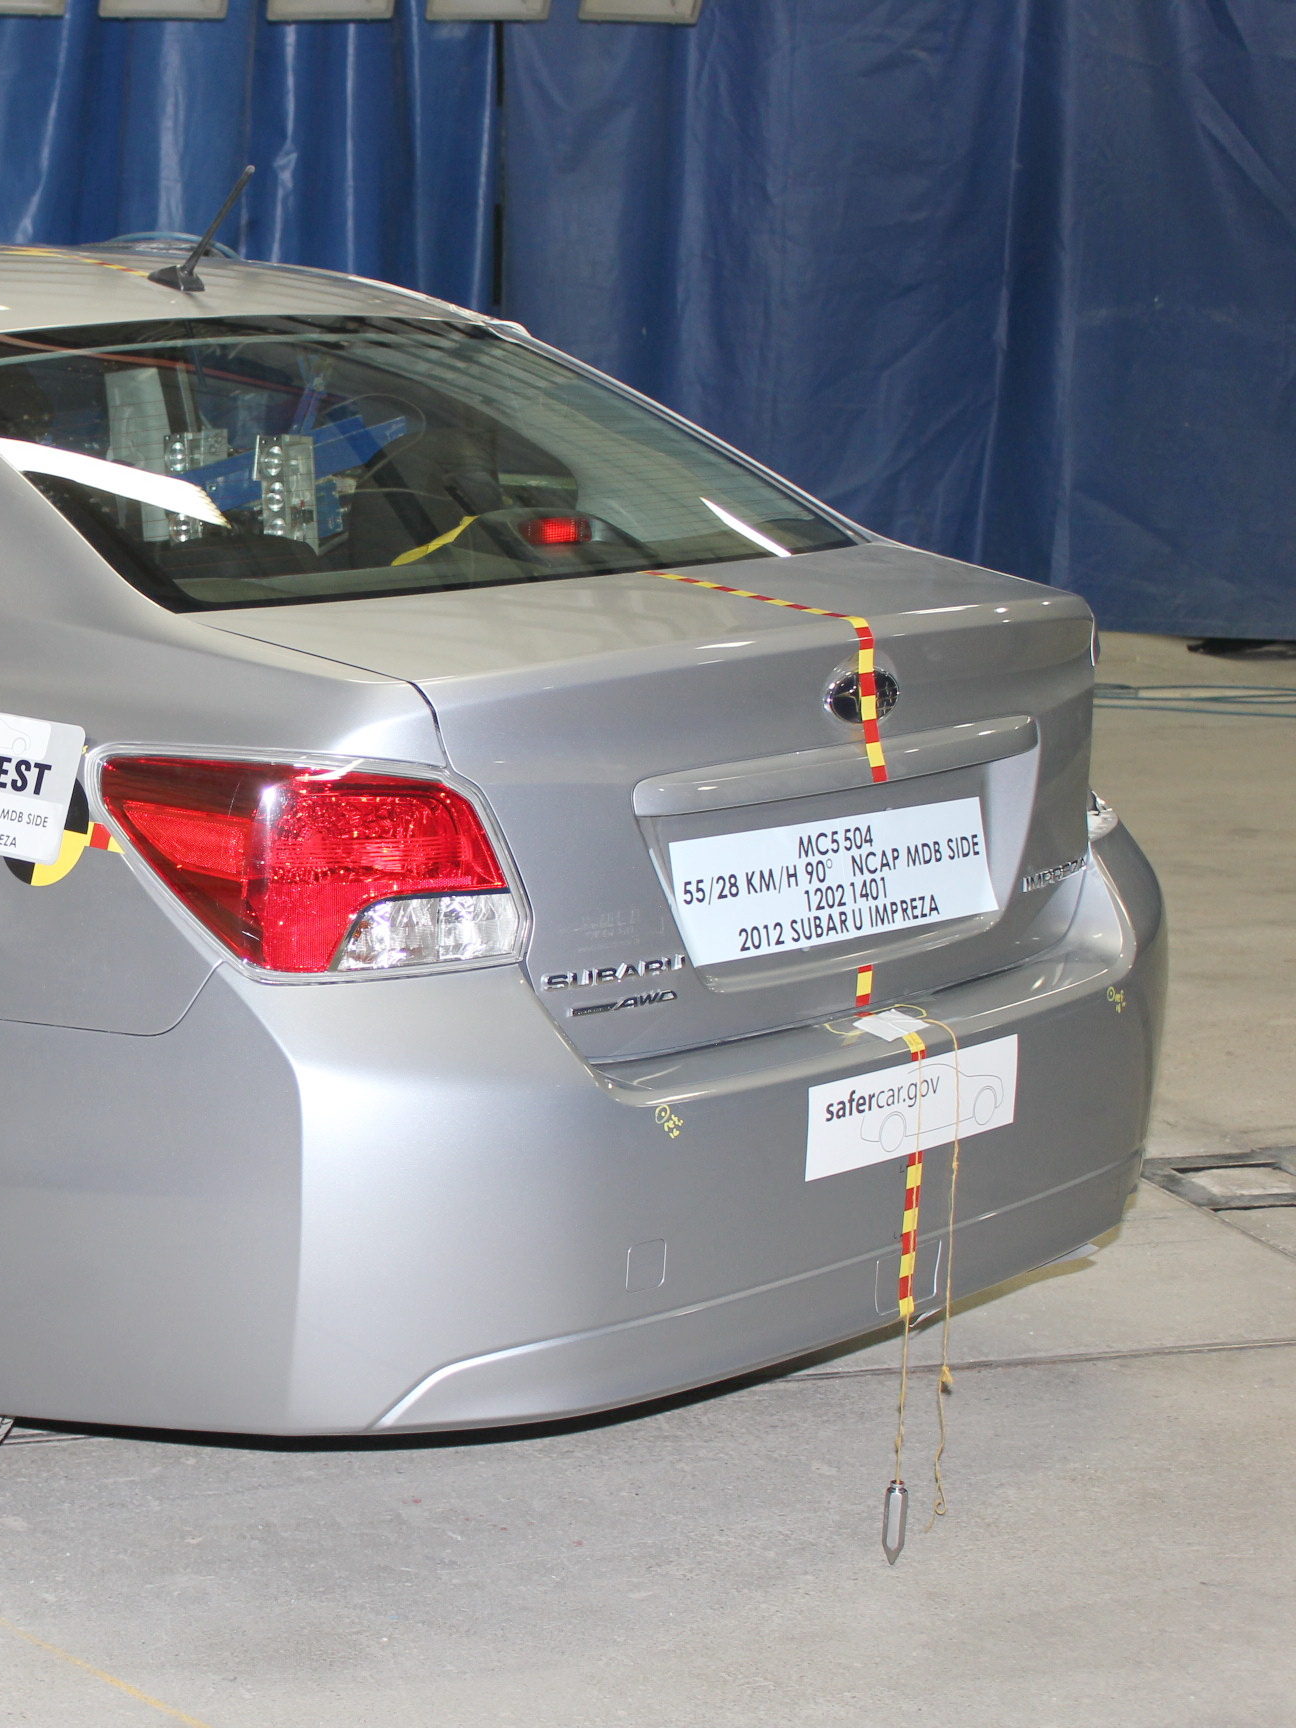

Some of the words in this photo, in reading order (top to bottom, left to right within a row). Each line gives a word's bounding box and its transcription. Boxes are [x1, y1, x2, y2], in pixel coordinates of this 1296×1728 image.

[0, 808, 24, 823] MDB
[26, 813, 49, 828] SIDE
[798, 824, 874, 860] MC5504
[683, 874, 740, 905] 55/28
[745, 864, 799, 895] KM/H
[851, 851, 900, 877] NCAP
[906, 842, 943, 868] MDB
[947, 834, 981, 860] SIDE
[804, 876, 888, 912] 12021401
[738, 922, 785, 952] 2012
[791, 908, 863, 943] SUBARU
[869, 894, 941, 928] IMPREZA
[541, 953, 687, 991] SUBARU
[612, 989, 678, 1011] AWD
[825, 1075, 941, 1123] safercar.gov
